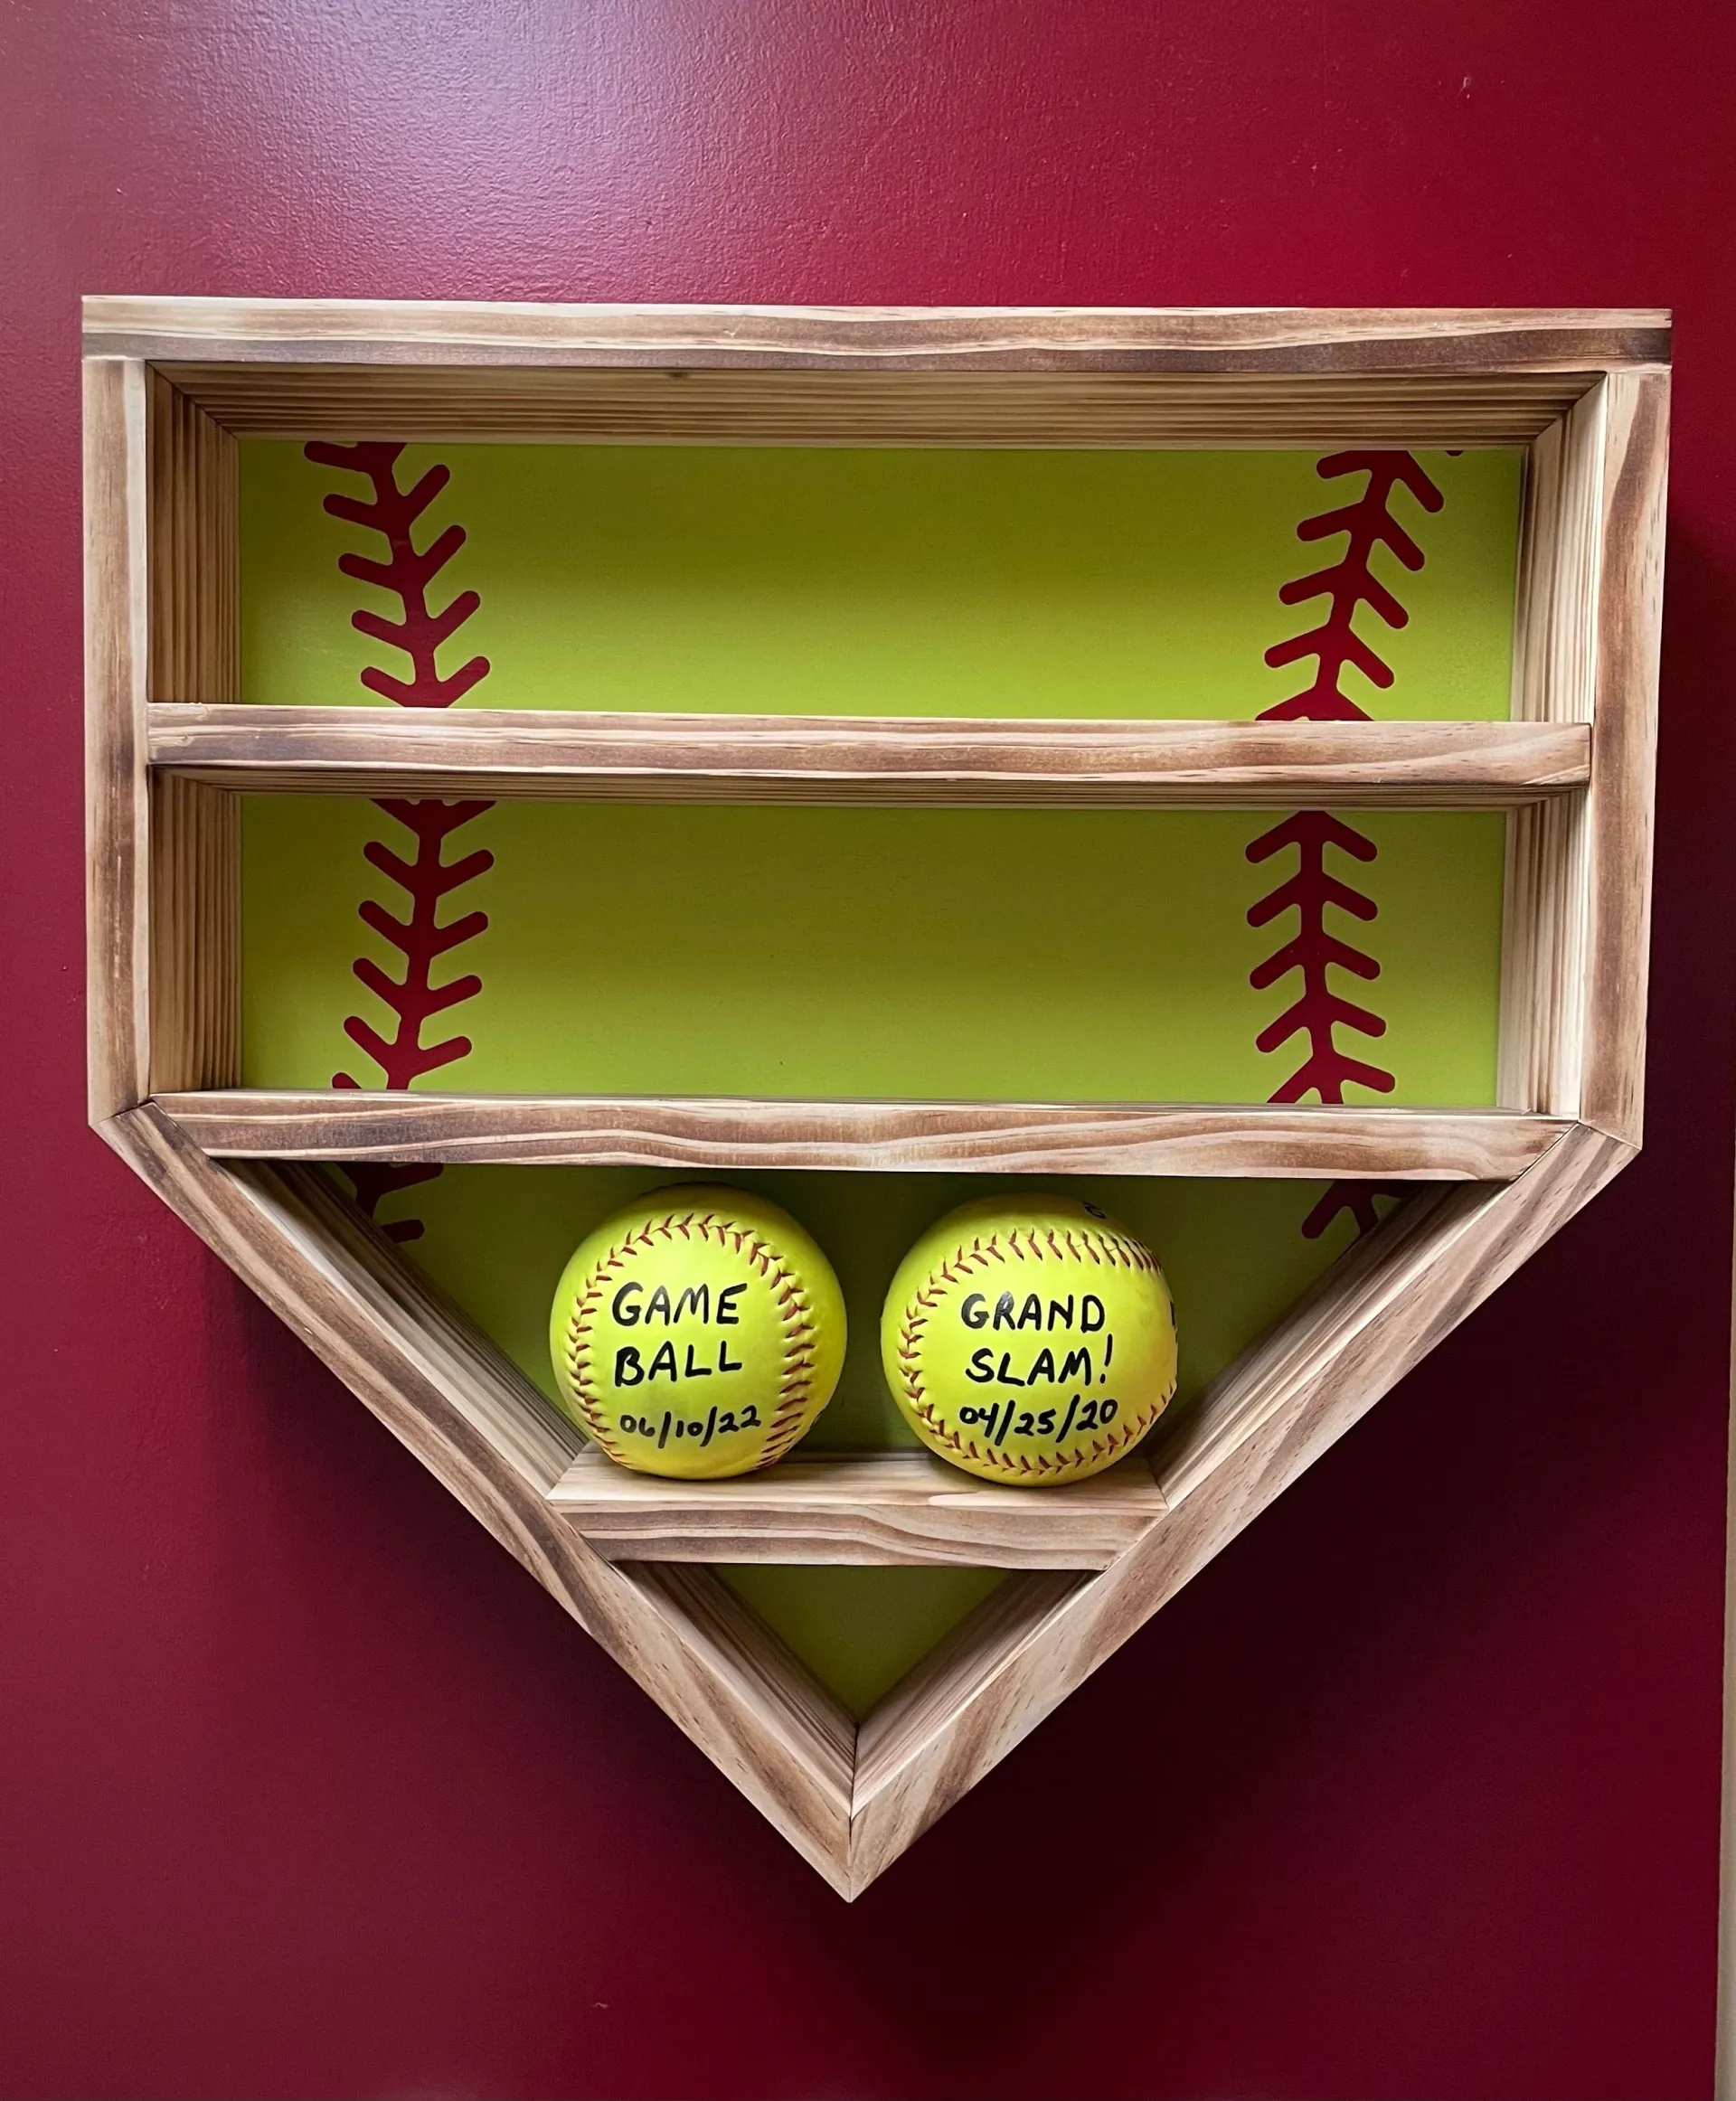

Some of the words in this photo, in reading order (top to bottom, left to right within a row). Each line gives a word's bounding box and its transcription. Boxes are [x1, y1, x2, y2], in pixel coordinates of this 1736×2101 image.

[612, 1282, 748, 1326] GAME
[961, 1293, 1105, 1334] GRAND
[614, 1340, 742, 1388] BALL
[965, 1333, 1114, 1387] SLAM!
[619, 1404, 761, 1449] 06/10/22
[959, 1393, 1118, 1446] 04/25/20
